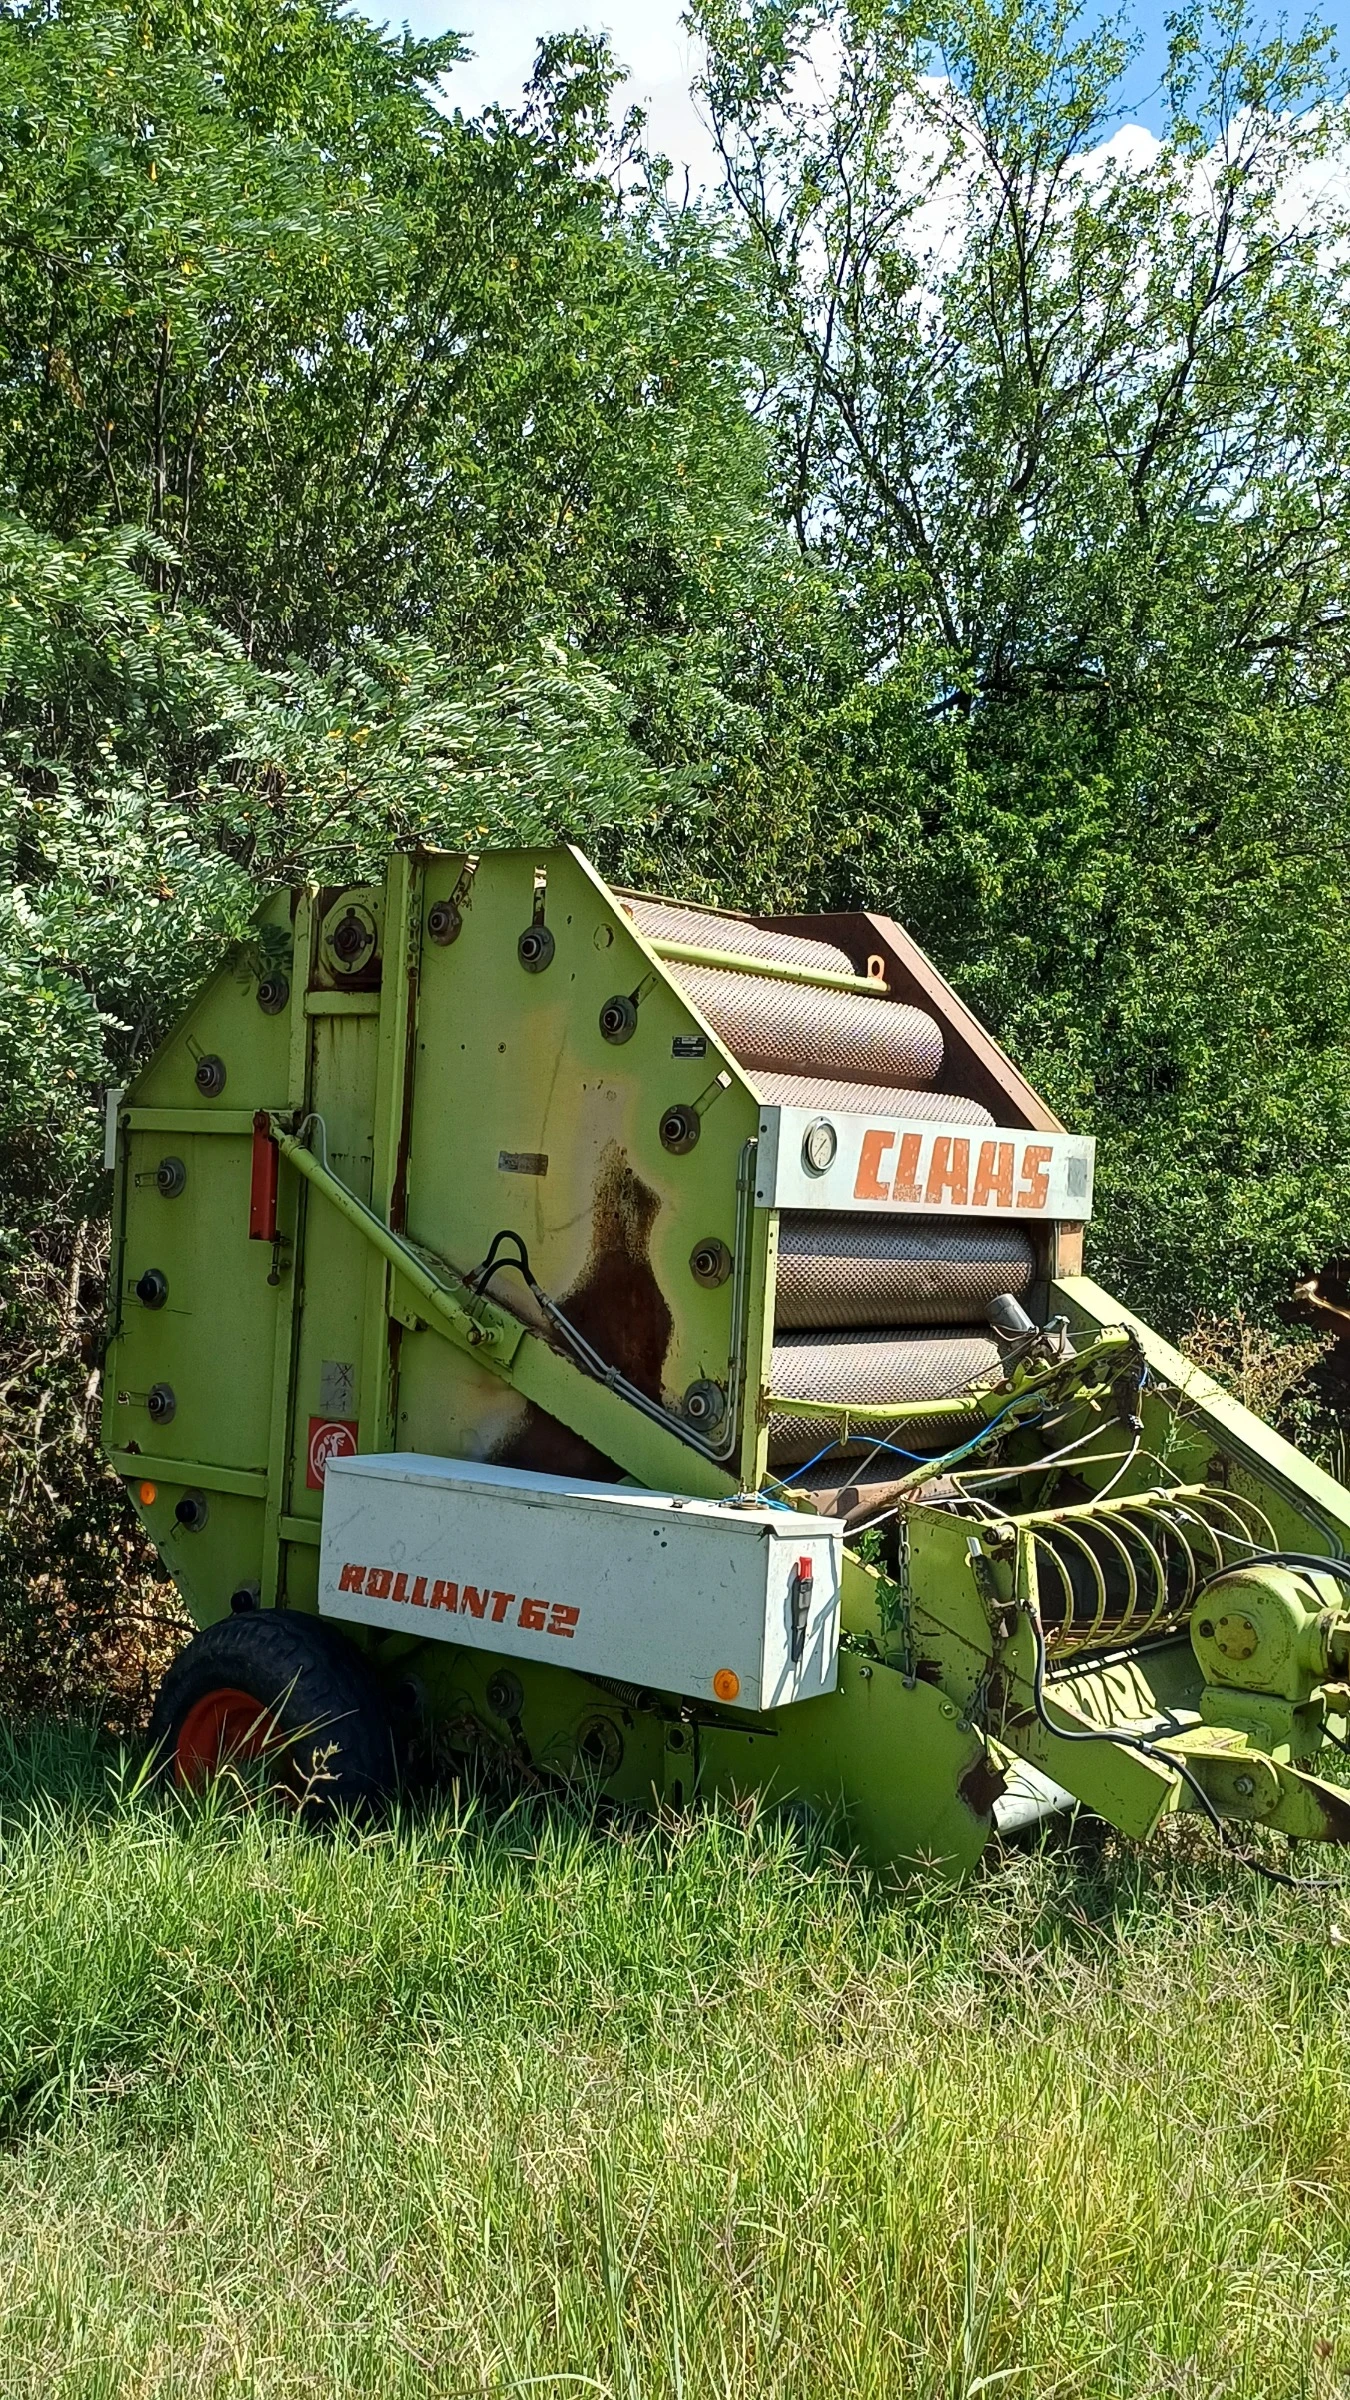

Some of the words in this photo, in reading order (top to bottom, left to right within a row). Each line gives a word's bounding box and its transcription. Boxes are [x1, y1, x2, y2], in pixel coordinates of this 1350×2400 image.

[853, 1129, 1054, 1209] CLAAS
[338, 1562, 516, 1624] ROLLANT
[517, 1597, 581, 1639] 62
